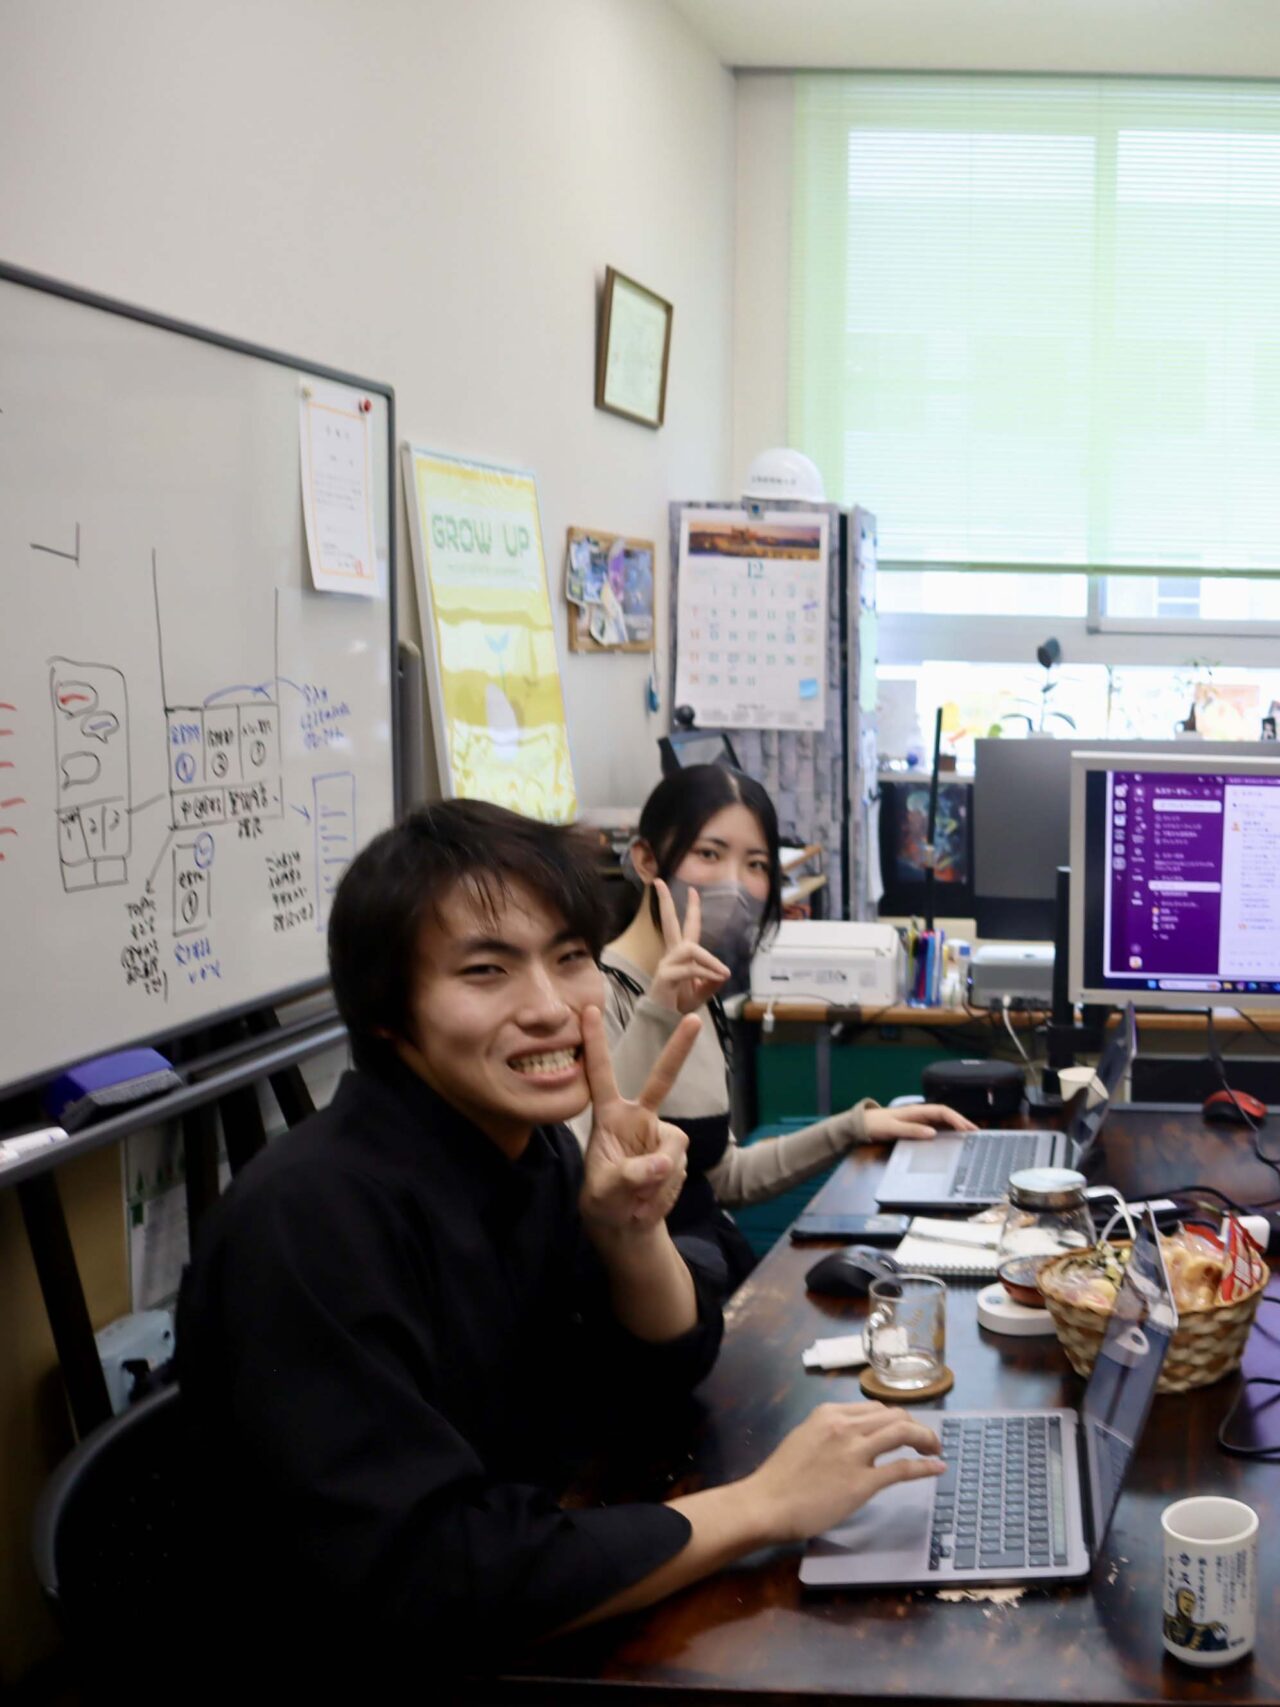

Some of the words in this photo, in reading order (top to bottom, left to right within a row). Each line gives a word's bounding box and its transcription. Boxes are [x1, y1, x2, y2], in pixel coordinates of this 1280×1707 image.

[431, 515, 492, 556] GROW
[501, 523, 529, 557] UP
[747, 561, 765, 578] 12
